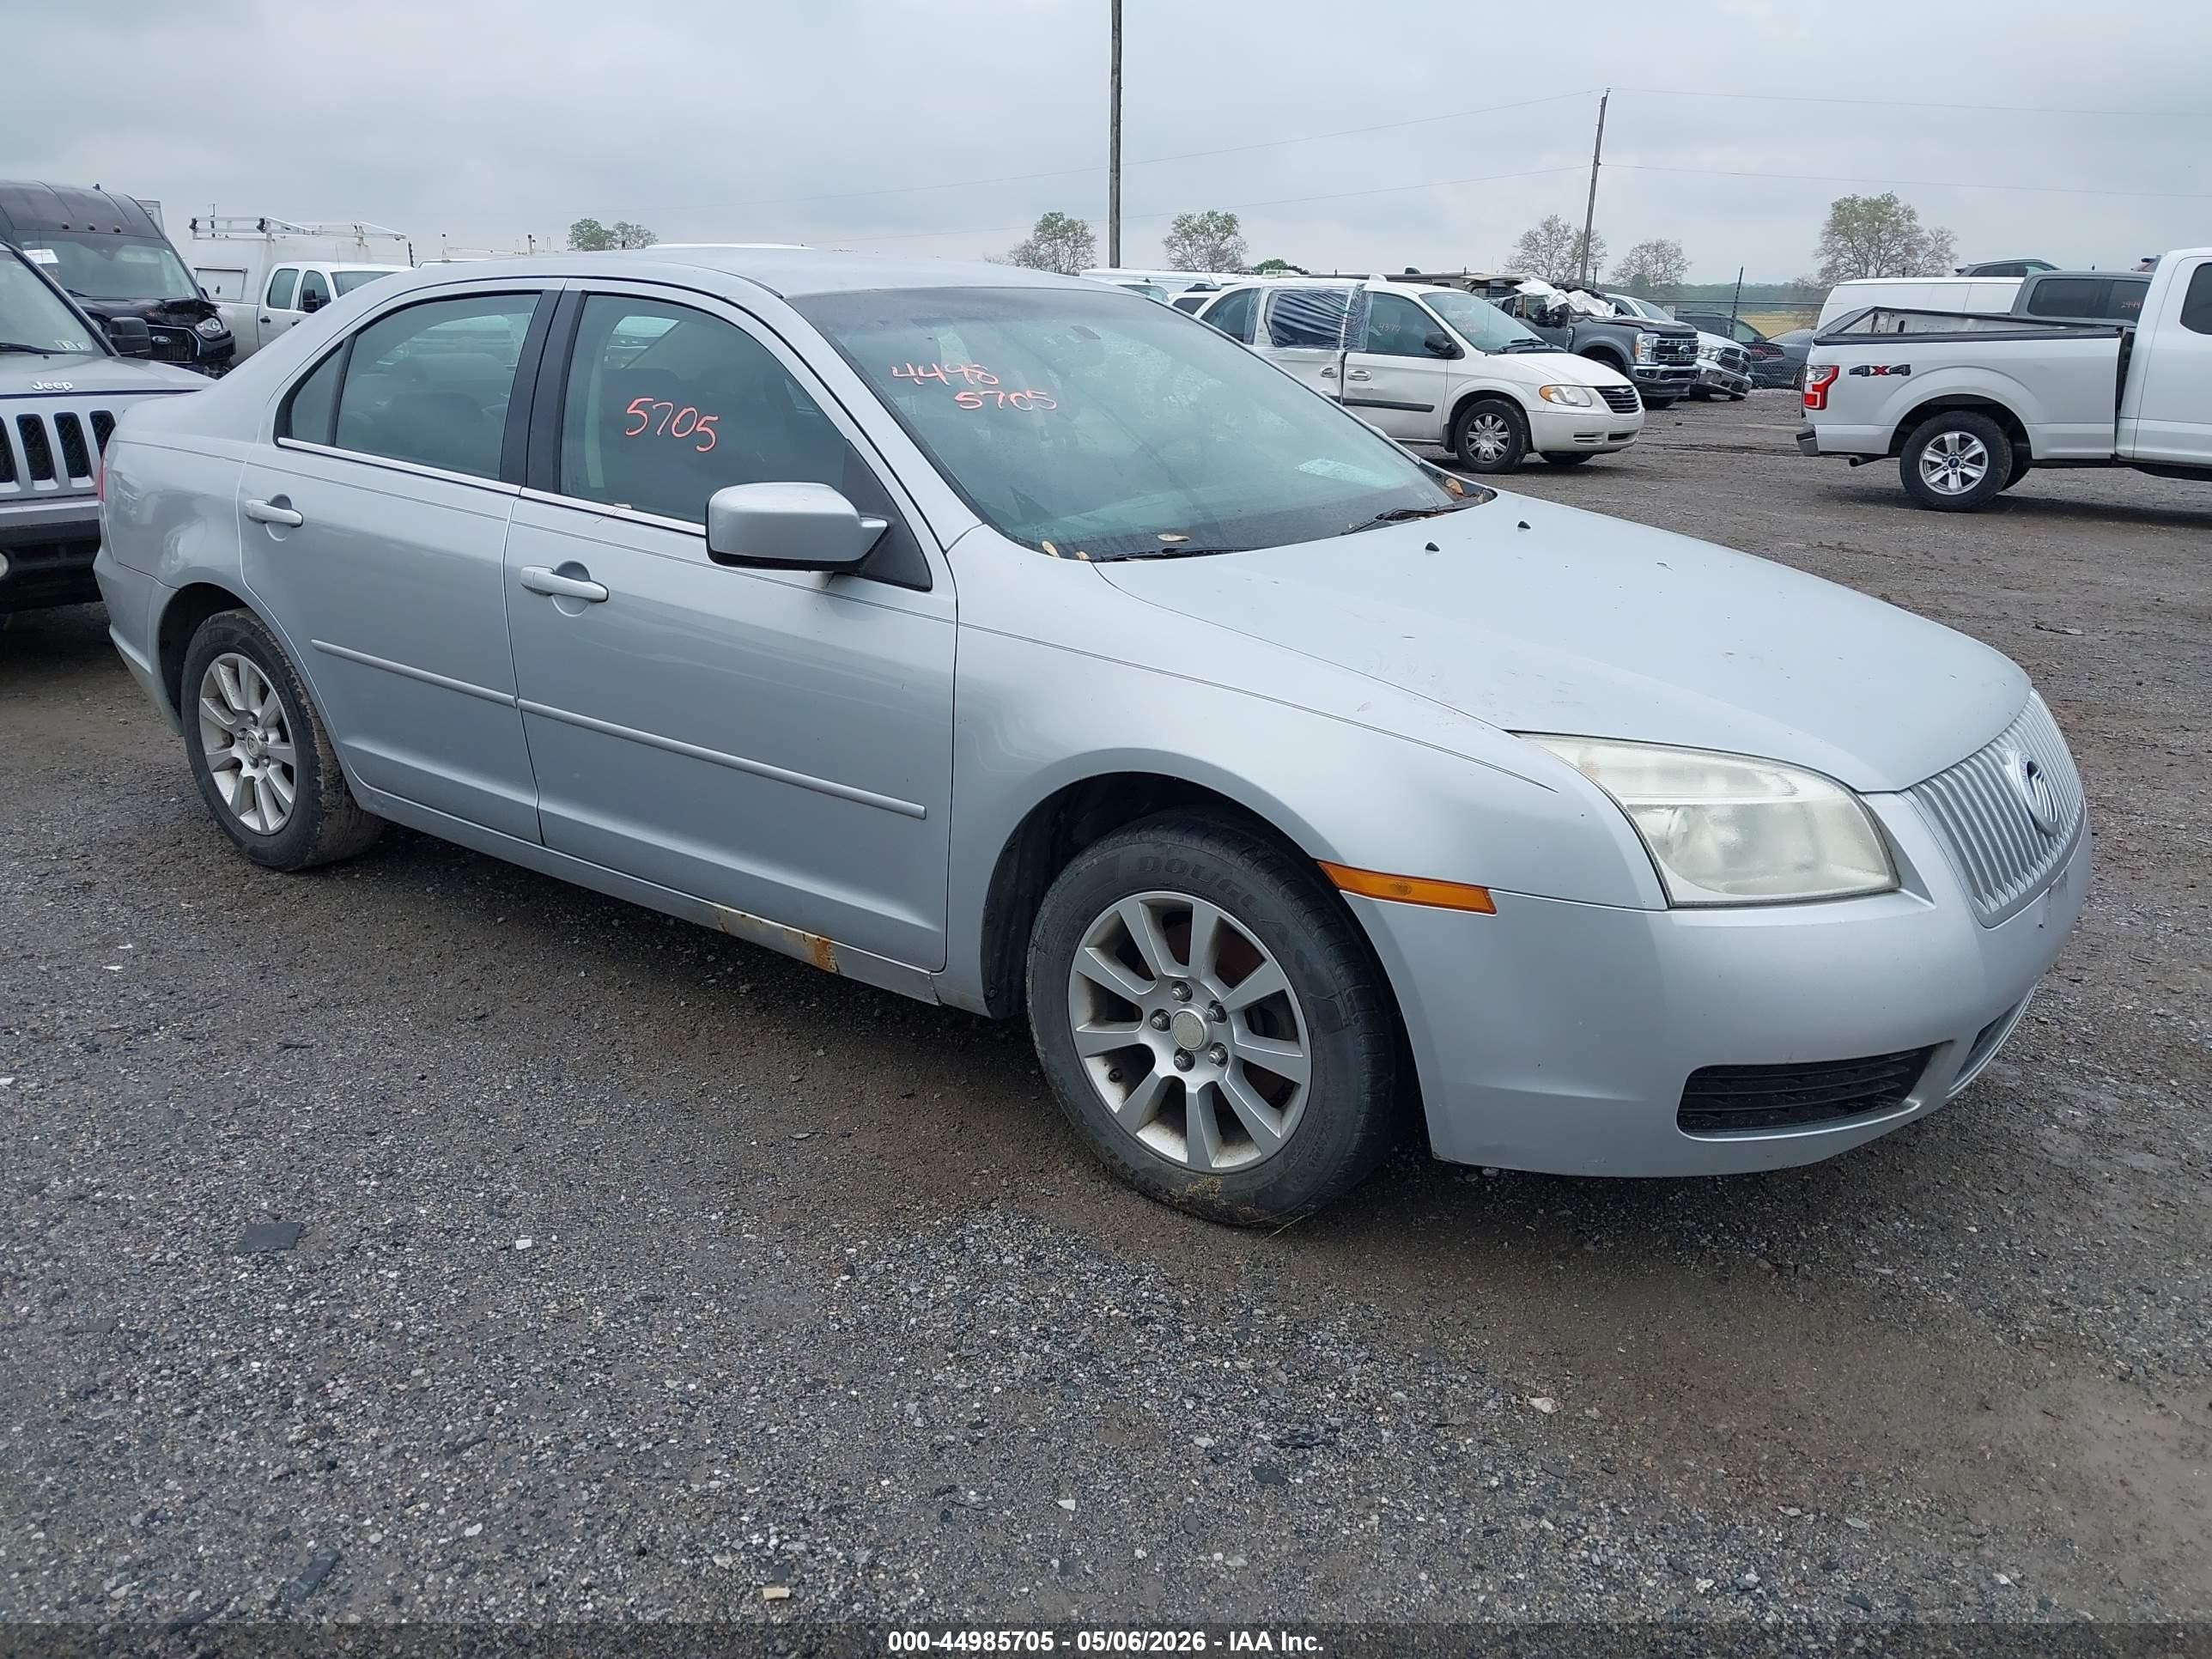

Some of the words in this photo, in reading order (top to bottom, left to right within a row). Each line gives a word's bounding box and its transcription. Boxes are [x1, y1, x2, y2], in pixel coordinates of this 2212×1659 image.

[891, 362, 1000, 386] 4498
[32, 380, 74, 392] Jeep
[955, 390, 1058, 412] 5705
[625, 397, 719, 453] 5705
